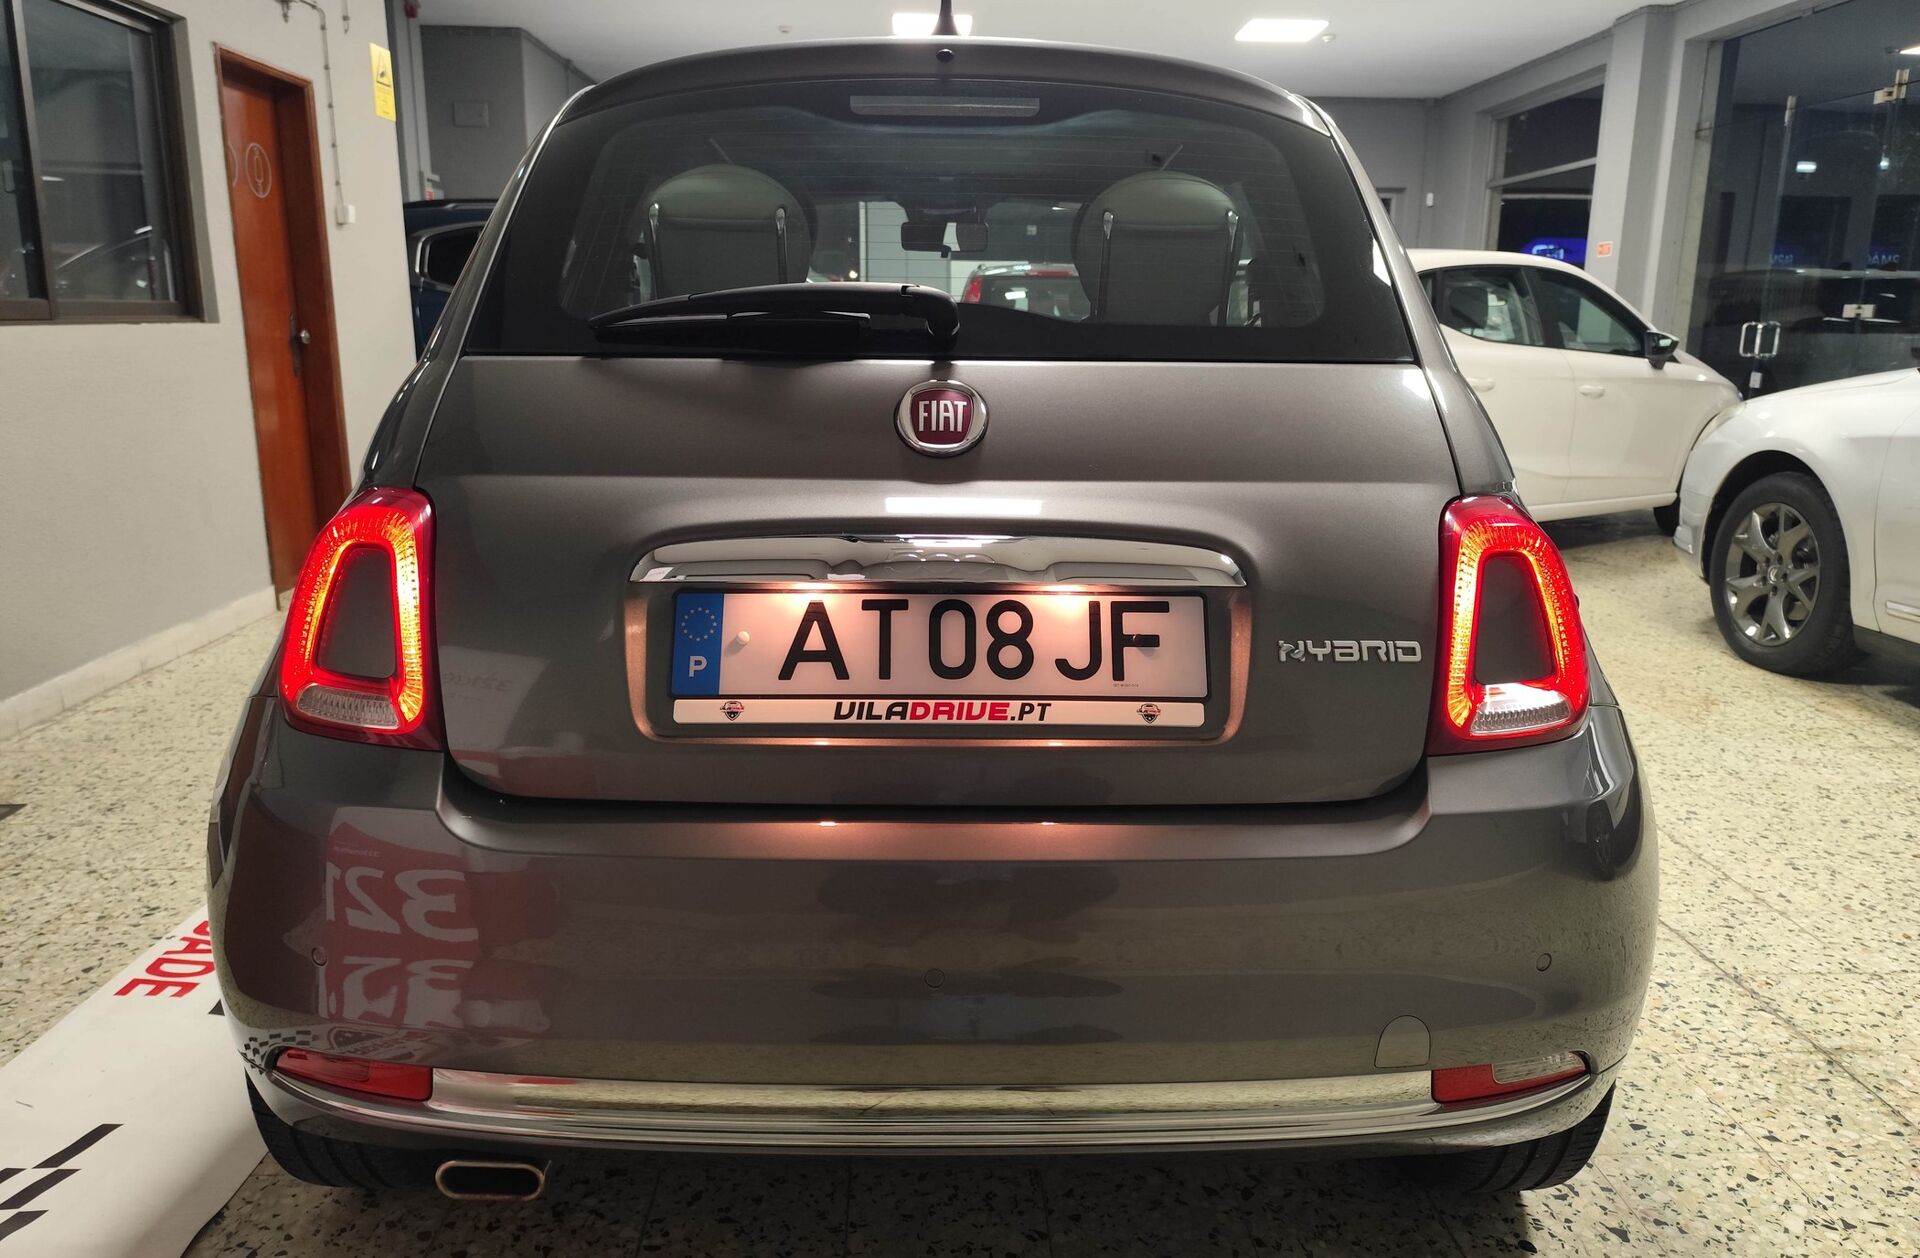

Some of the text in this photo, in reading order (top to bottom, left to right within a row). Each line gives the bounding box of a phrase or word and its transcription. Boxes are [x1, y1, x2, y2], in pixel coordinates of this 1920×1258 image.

[918, 400, 967, 432] FIAT
[778, 599, 1170, 682] AT 08 JF
[1277, 639, 1423, 663] HYBRID
[688, 655, 708, 678] P
